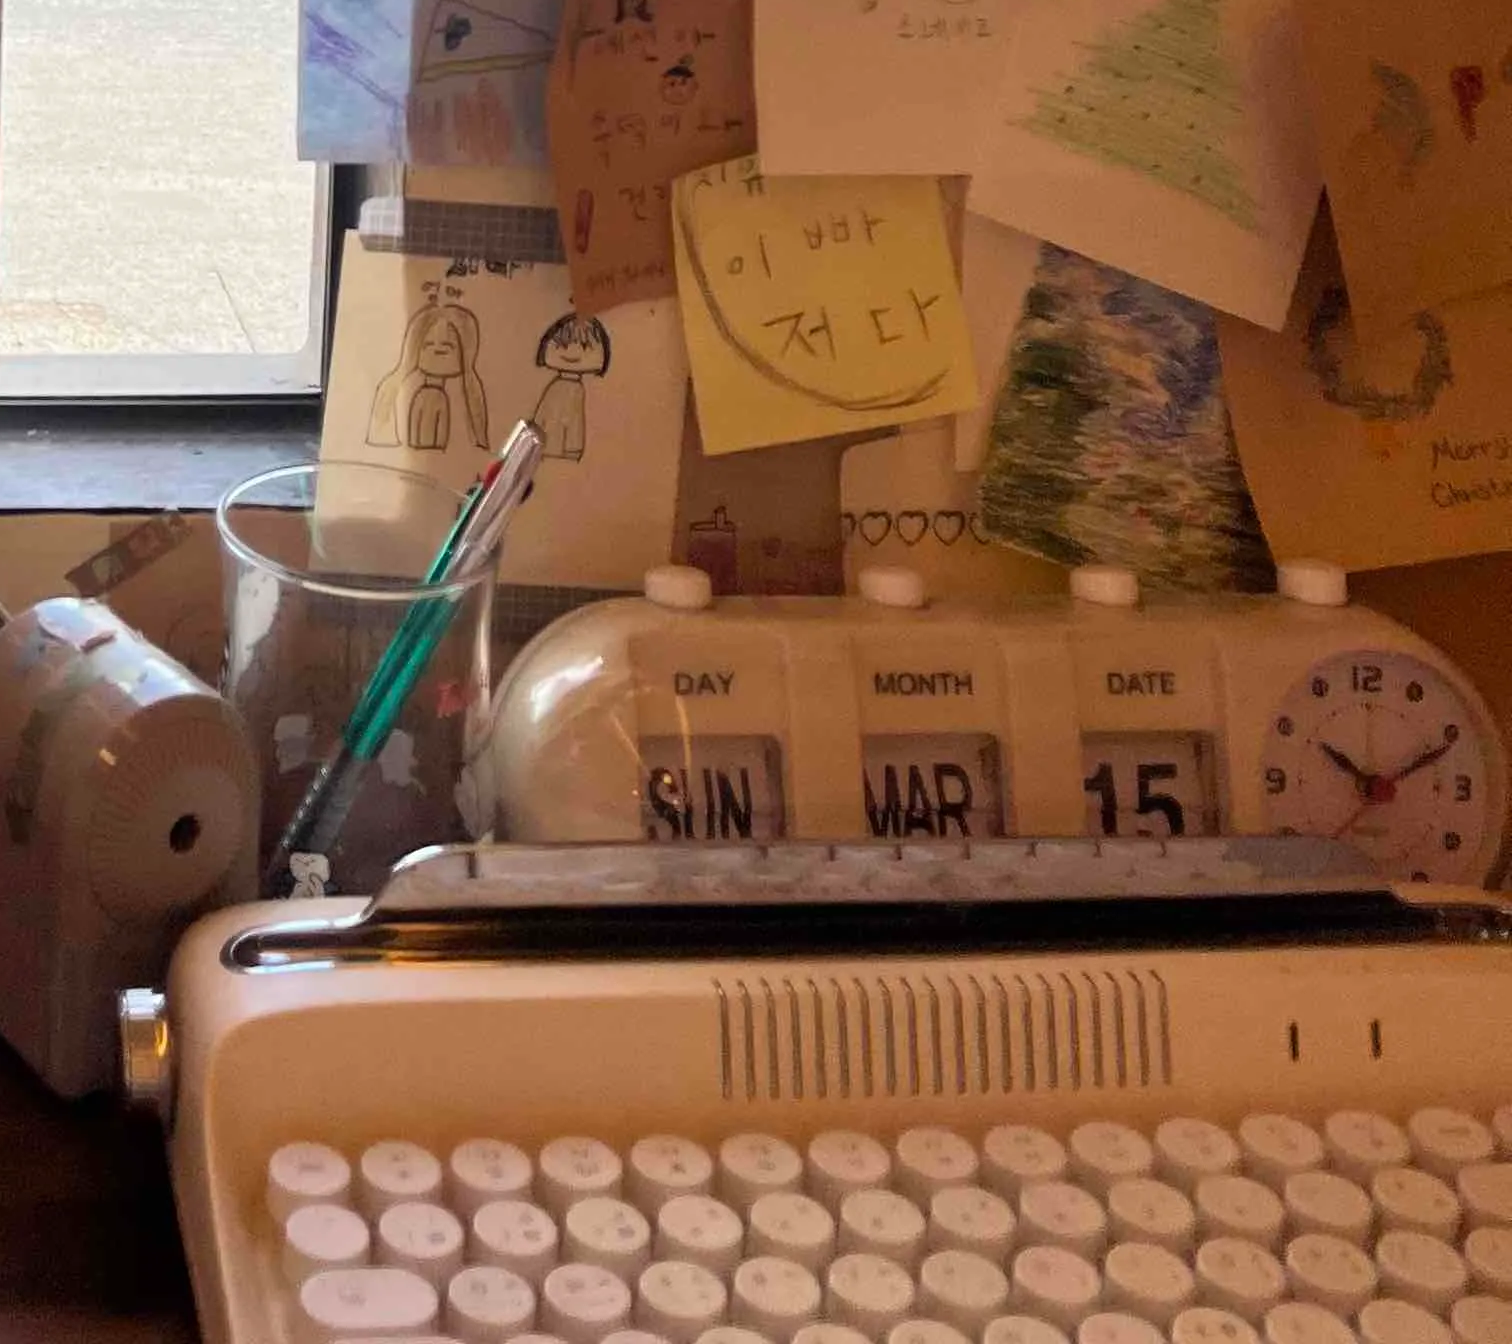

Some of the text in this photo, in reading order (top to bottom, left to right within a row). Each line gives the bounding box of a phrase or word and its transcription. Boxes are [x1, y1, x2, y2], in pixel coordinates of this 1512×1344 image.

[674, 671, 1177, 696] DAY MONTH DATE
[1352, 665, 1383, 692] 12
[1265, 767, 1287, 794] 9
[1454, 774, 1472, 802] 3
[1083, 761, 1185, 838] 15
